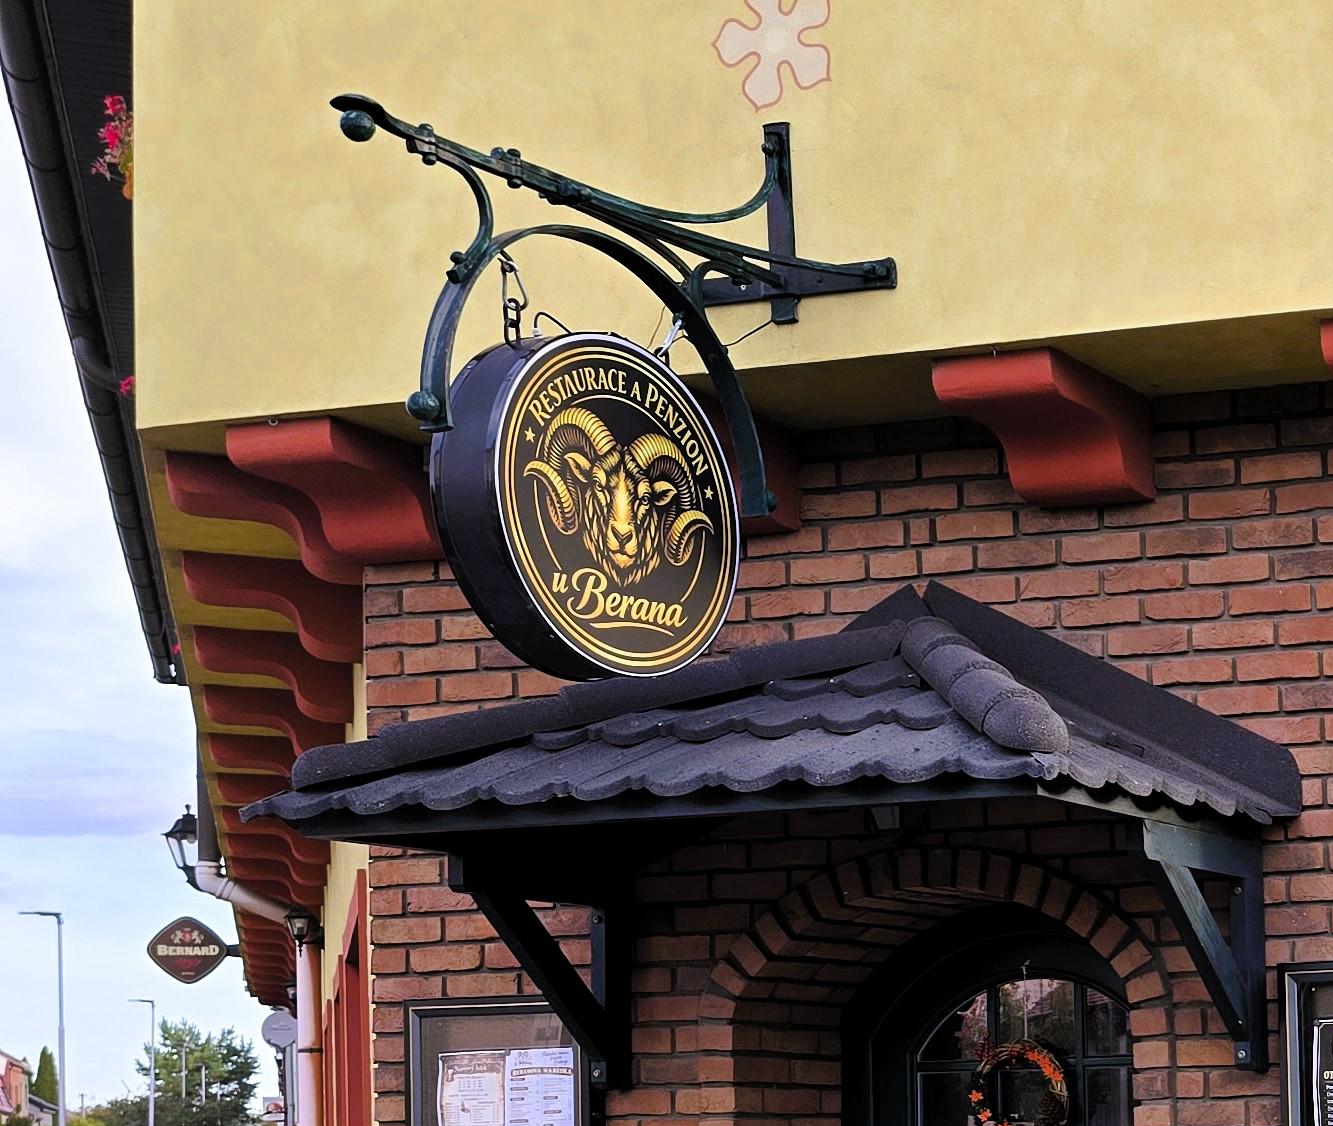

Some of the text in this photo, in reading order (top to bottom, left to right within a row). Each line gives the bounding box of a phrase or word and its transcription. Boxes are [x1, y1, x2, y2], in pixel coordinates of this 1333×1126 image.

[528, 367, 709, 477] RESTAURACE A PENZION
[552, 567, 689, 629] u Berana
[157, 944, 220, 956] BERNARD
